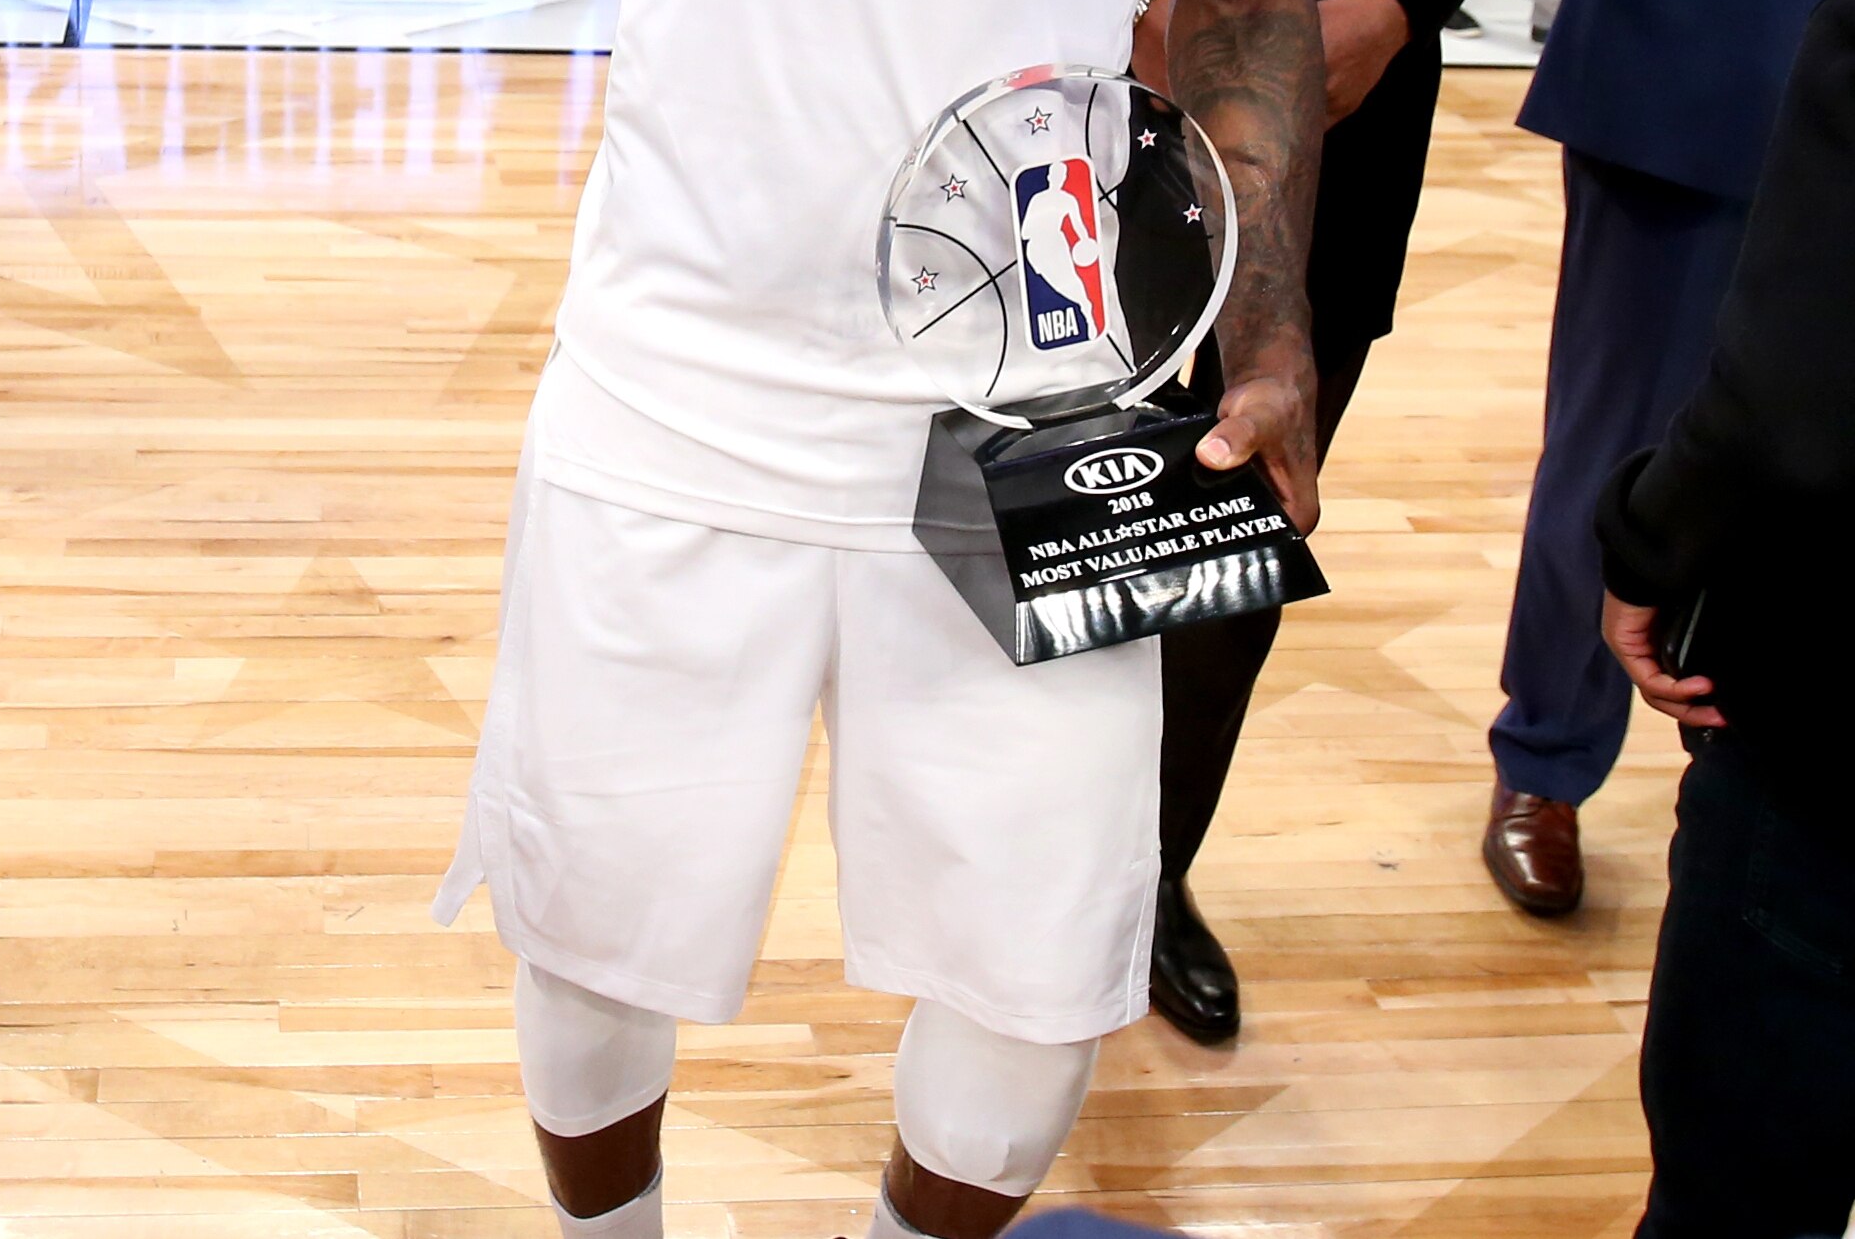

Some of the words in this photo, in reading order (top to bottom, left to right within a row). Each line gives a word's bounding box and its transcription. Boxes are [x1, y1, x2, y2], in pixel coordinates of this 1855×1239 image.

[1036, 306, 1081, 343] NBA
[1076, 454, 1152, 490] KIA
[1107, 491, 1154, 515] 2018
[1028, 538, 1077, 561] NBA
[1189, 496, 1256, 523] GAME
[1019, 560, 1084, 589] MOST
[1084, 534, 1200, 573] VALUABLE
[1200, 514, 1288, 547] PLAYER
